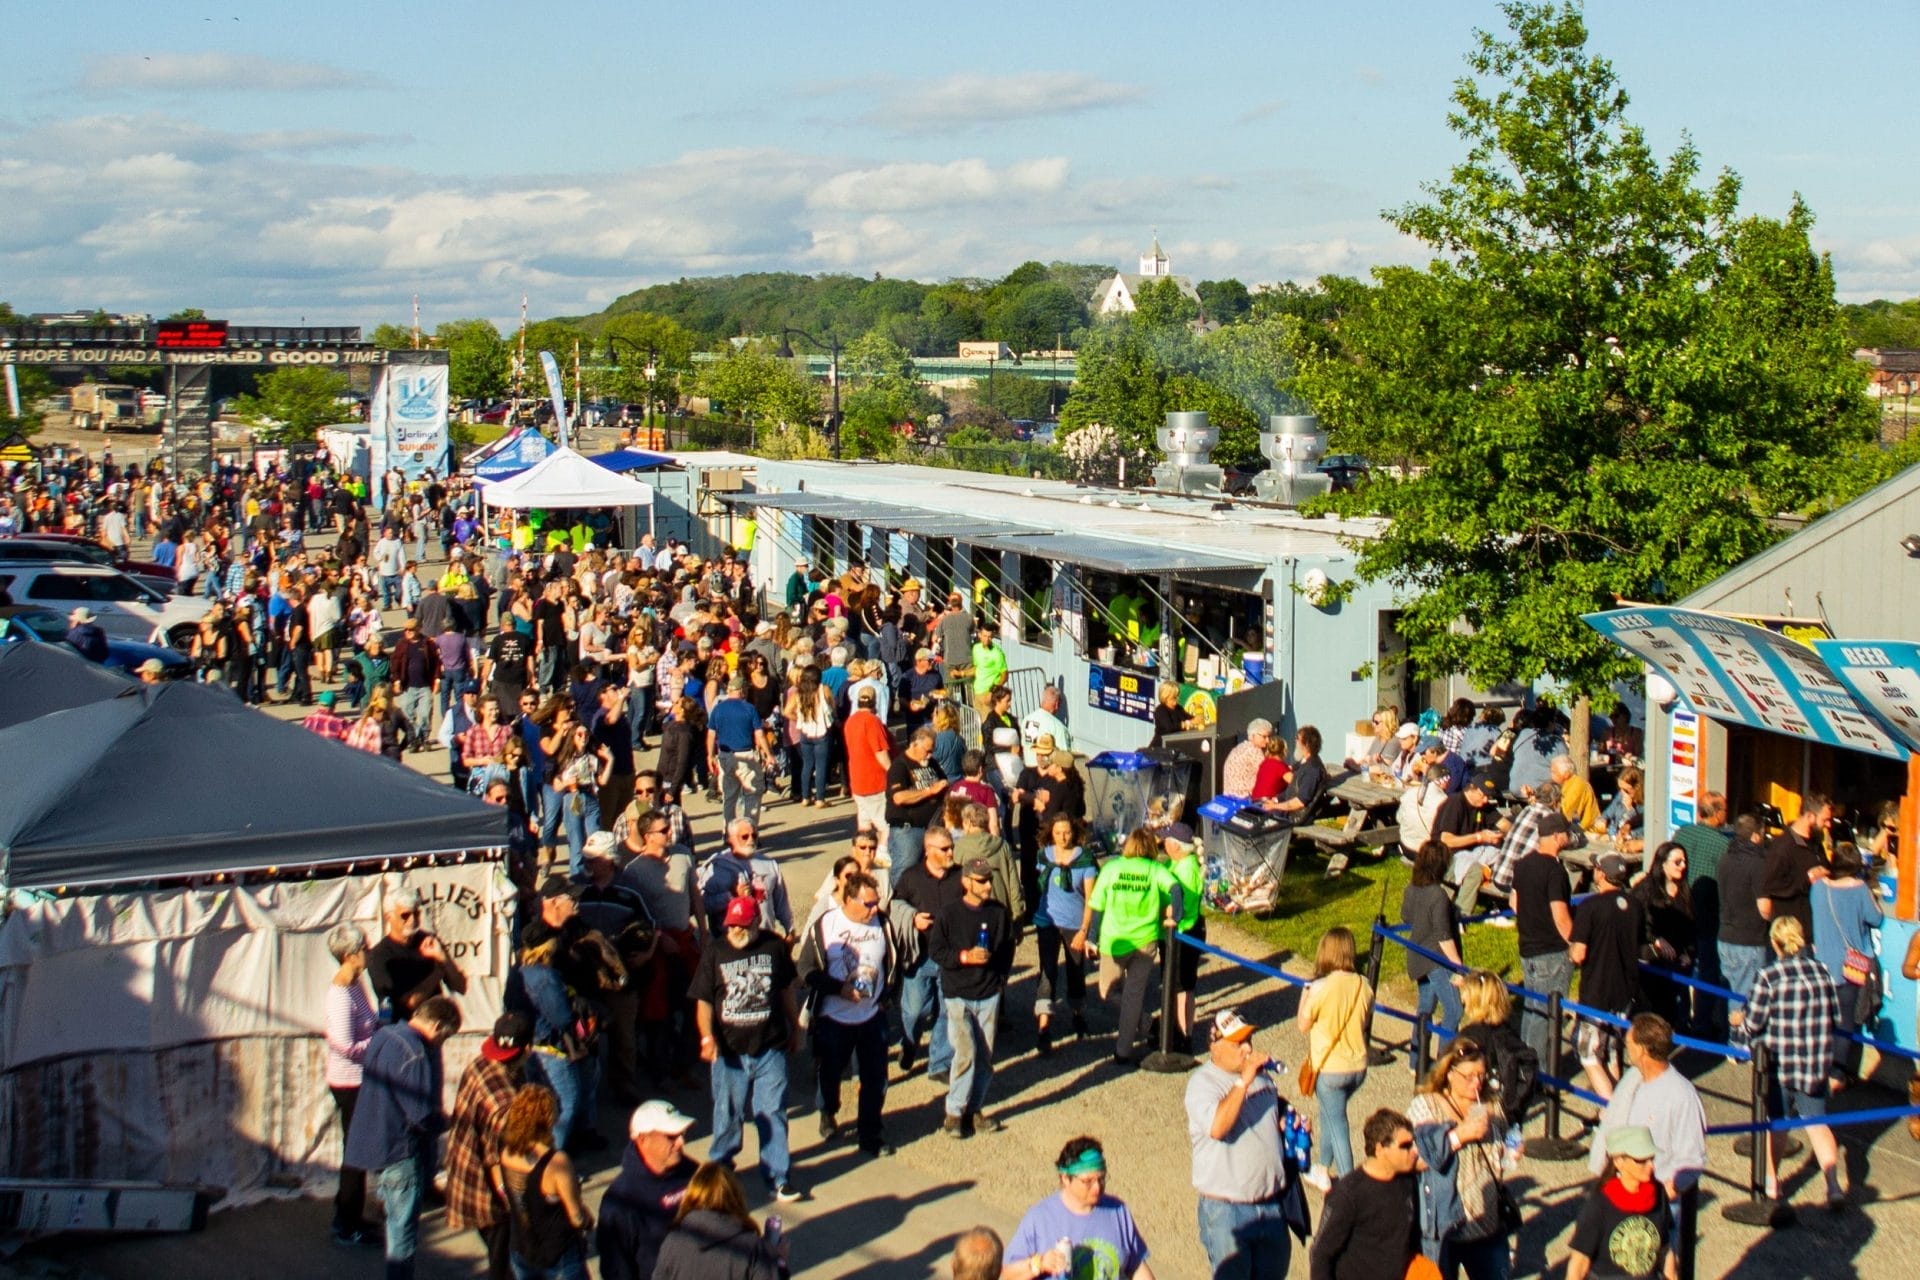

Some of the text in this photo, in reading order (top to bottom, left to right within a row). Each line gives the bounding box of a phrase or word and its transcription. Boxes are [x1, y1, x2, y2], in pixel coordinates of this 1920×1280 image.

[20, 350, 69, 361] HOPE
[72, 350, 108, 361] YOU
[109, 350, 147, 361] HAD
[149, 350, 161, 361] A
[168, 351, 264, 363] WICKED
[270, 351, 339, 363] GOOD
[342, 350, 389, 363] TIME!
[1607, 613, 1653, 629] BEER
[1840, 647, 1893, 665] BEER
[417, 883, 487, 920] LLIE'S
[839, 929, 880, 951] Fender
